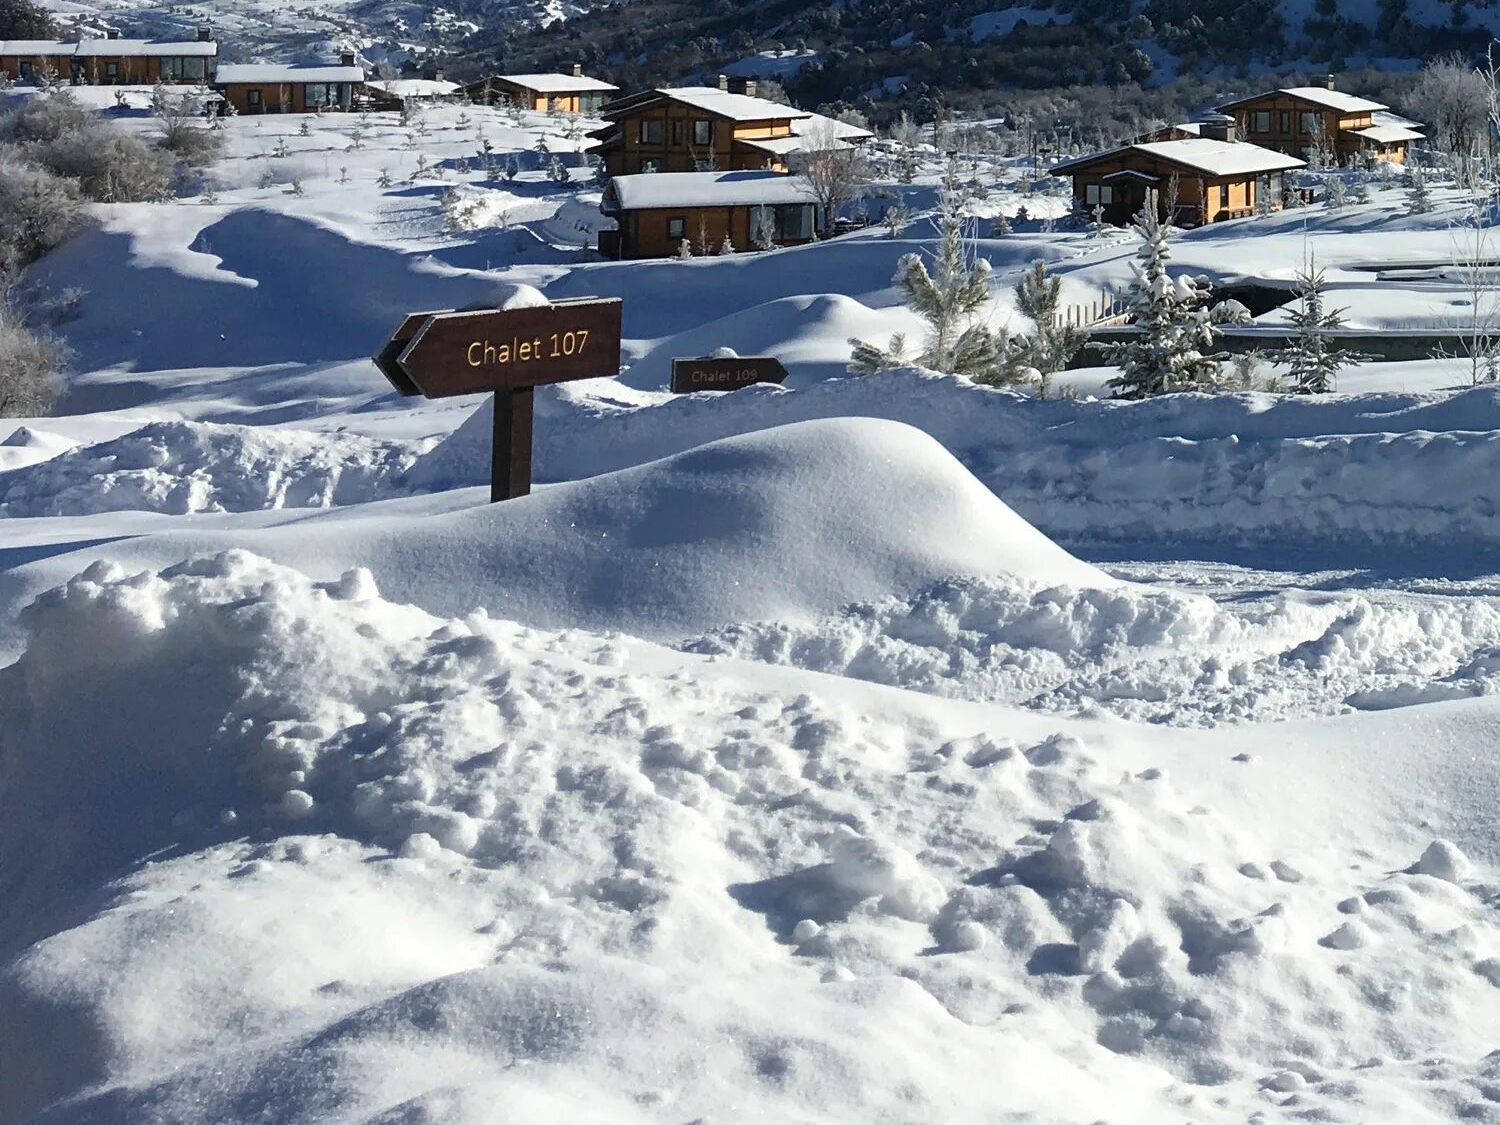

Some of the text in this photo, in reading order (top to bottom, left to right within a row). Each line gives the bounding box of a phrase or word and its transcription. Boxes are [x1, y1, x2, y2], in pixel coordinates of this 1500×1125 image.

[467, 330, 589, 367] Chalet 107
[691, 369, 758, 383] Chalet 109
